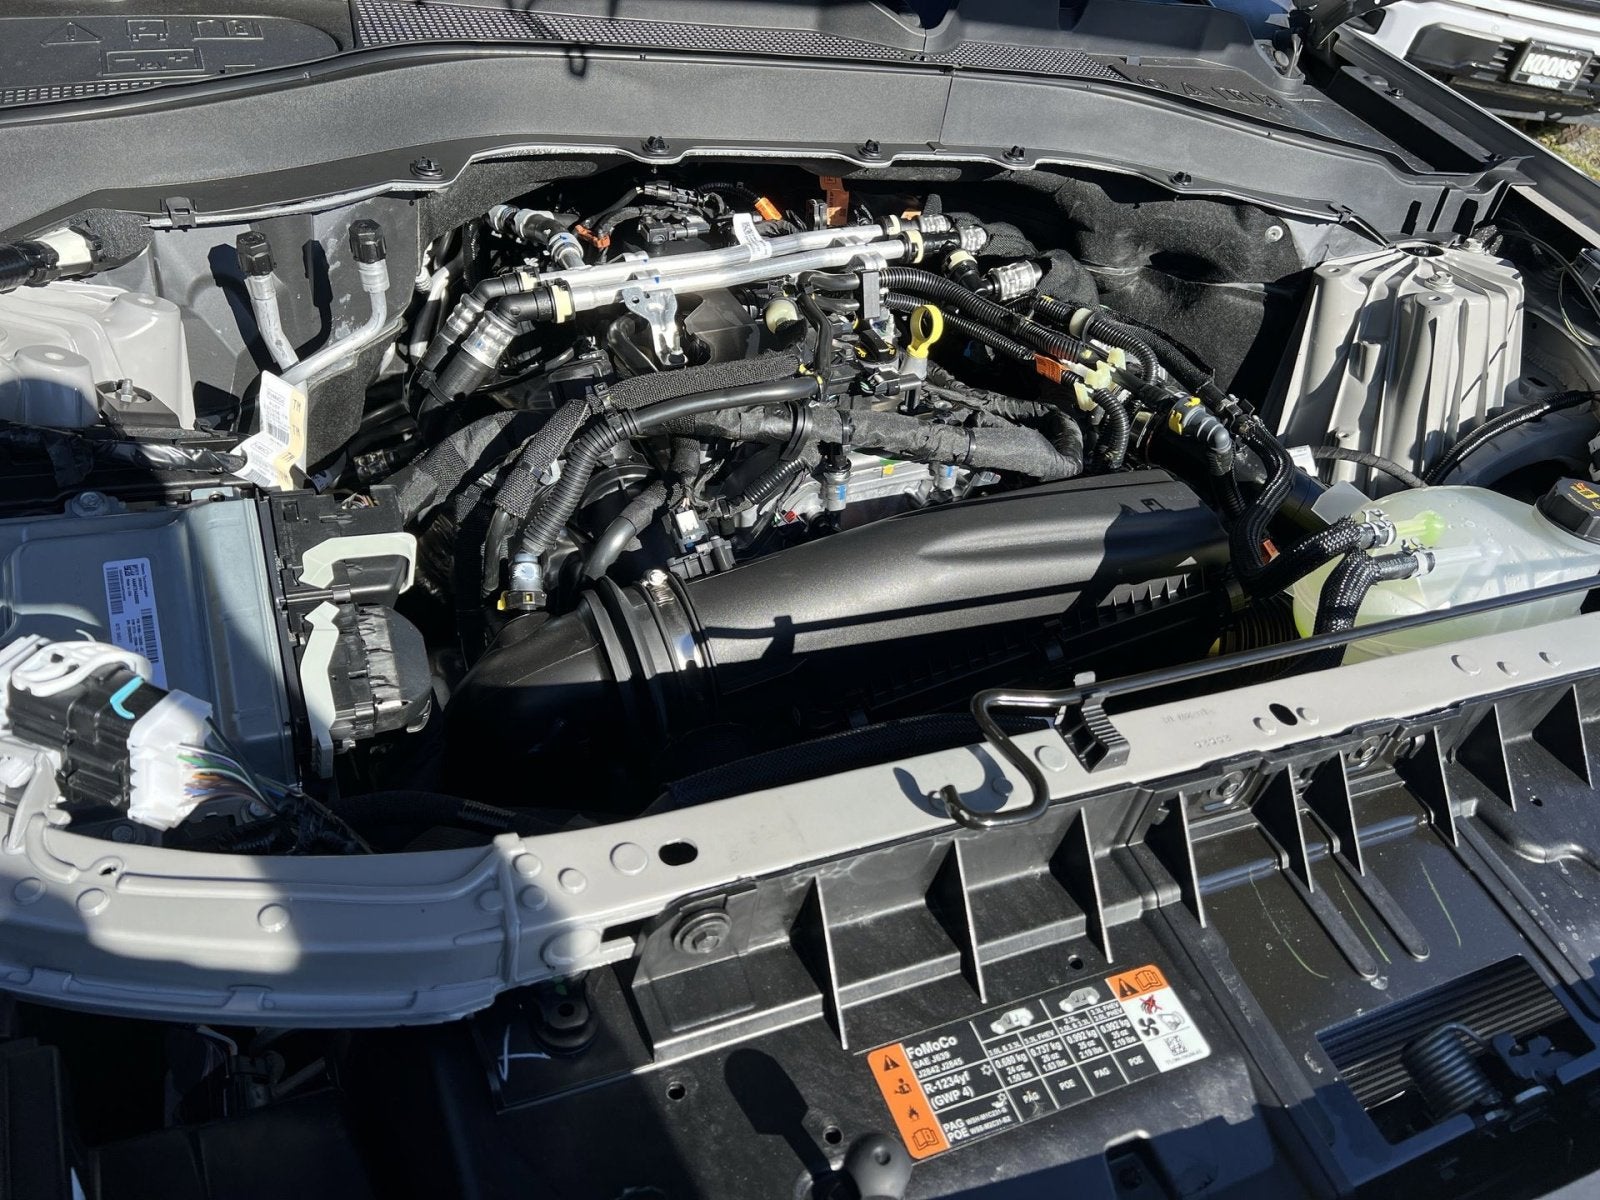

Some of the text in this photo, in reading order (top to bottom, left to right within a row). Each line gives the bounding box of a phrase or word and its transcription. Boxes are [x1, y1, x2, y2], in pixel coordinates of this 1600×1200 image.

[1521, 53, 1581, 80] KOONS
[1119, 1019, 1131, 1028] kg
[1086, 1029, 1098, 1038] kg
[906, 1036, 958, 1059] FoMoCo
[1050, 1042, 1062, 1050] kg
[912, 1056, 931, 1069] SAE
[1015, 1053, 1028, 1062] kg
[1128, 1055, 1144, 1066] POE
[1093, 1067, 1111, 1078] PAG
[924, 1071, 970, 1094] R-1234yf
[1059, 1079, 1076, 1090] POE
[931, 1086, 975, 1110] (GWP 4)
[1022, 1091, 1040, 1103] PAG
[943, 1119, 965, 1132] PAG
[947, 1128, 970, 1142] POE
